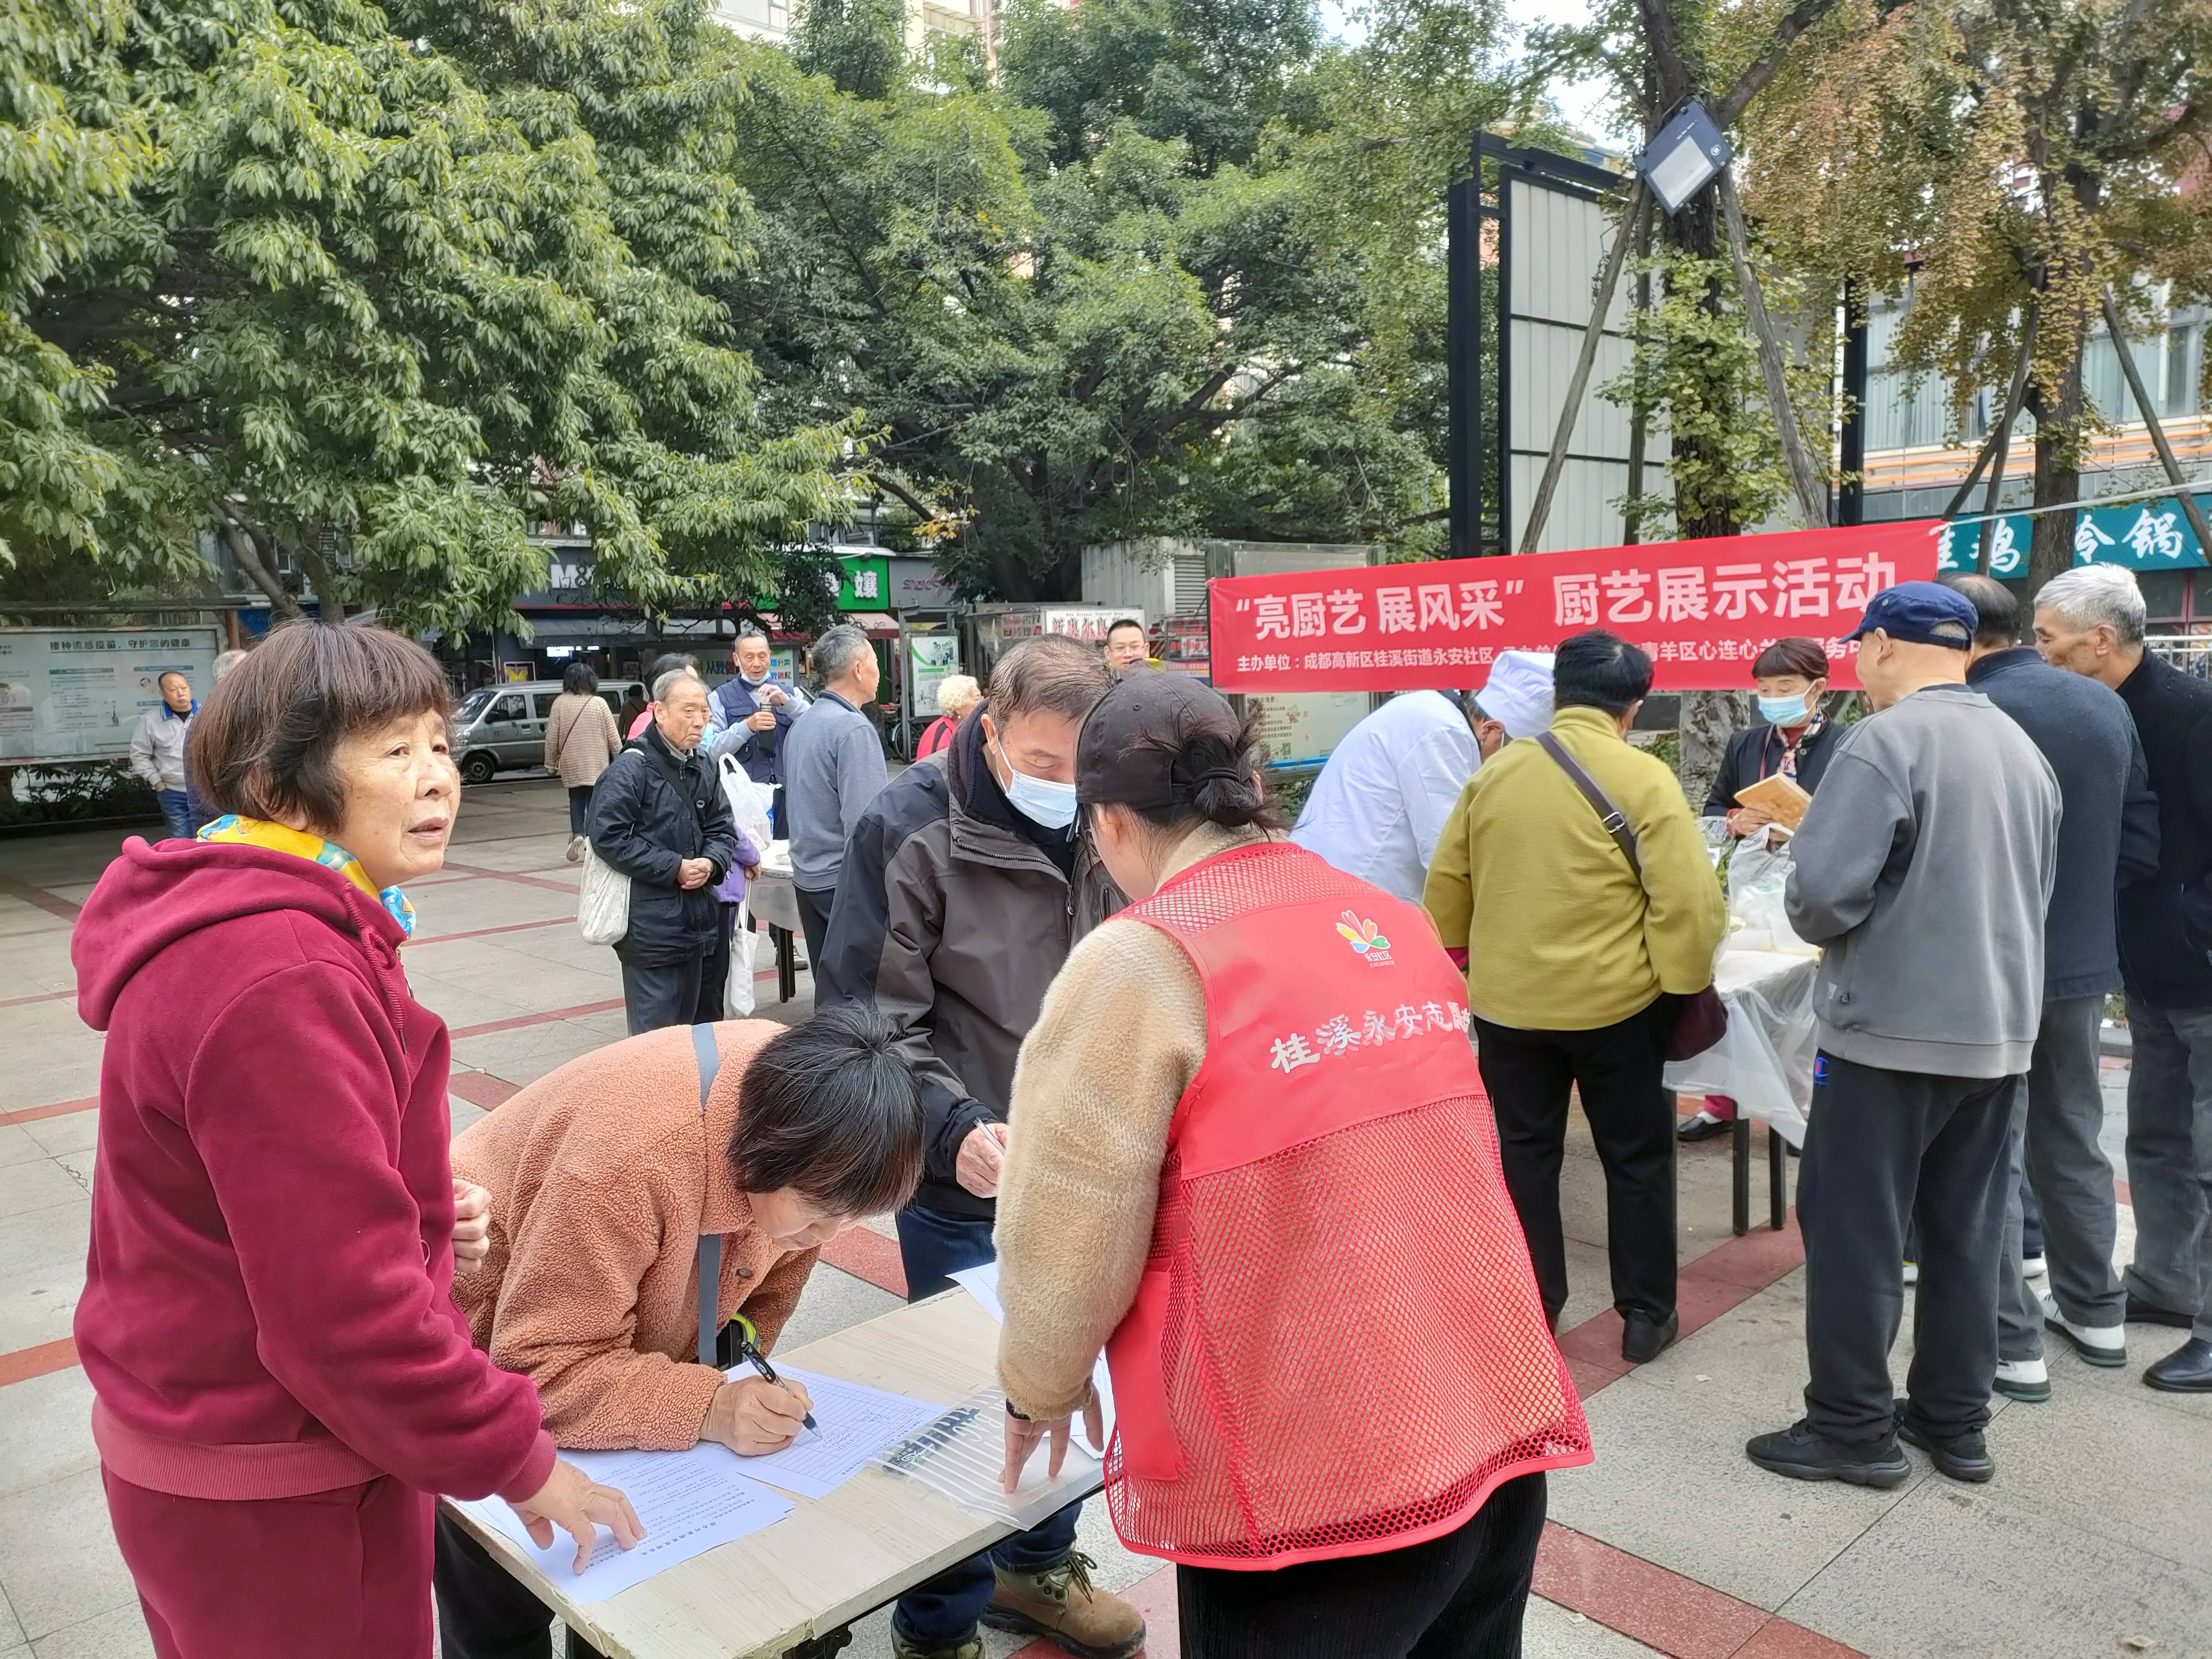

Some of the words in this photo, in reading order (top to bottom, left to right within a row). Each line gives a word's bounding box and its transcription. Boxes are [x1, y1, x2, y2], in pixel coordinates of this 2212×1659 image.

[2075, 509, 2212, 564] 冷锅
[1553, 552, 1896, 627] 厨艺展示活动
[952, 1413, 1004, 1442] BAG
